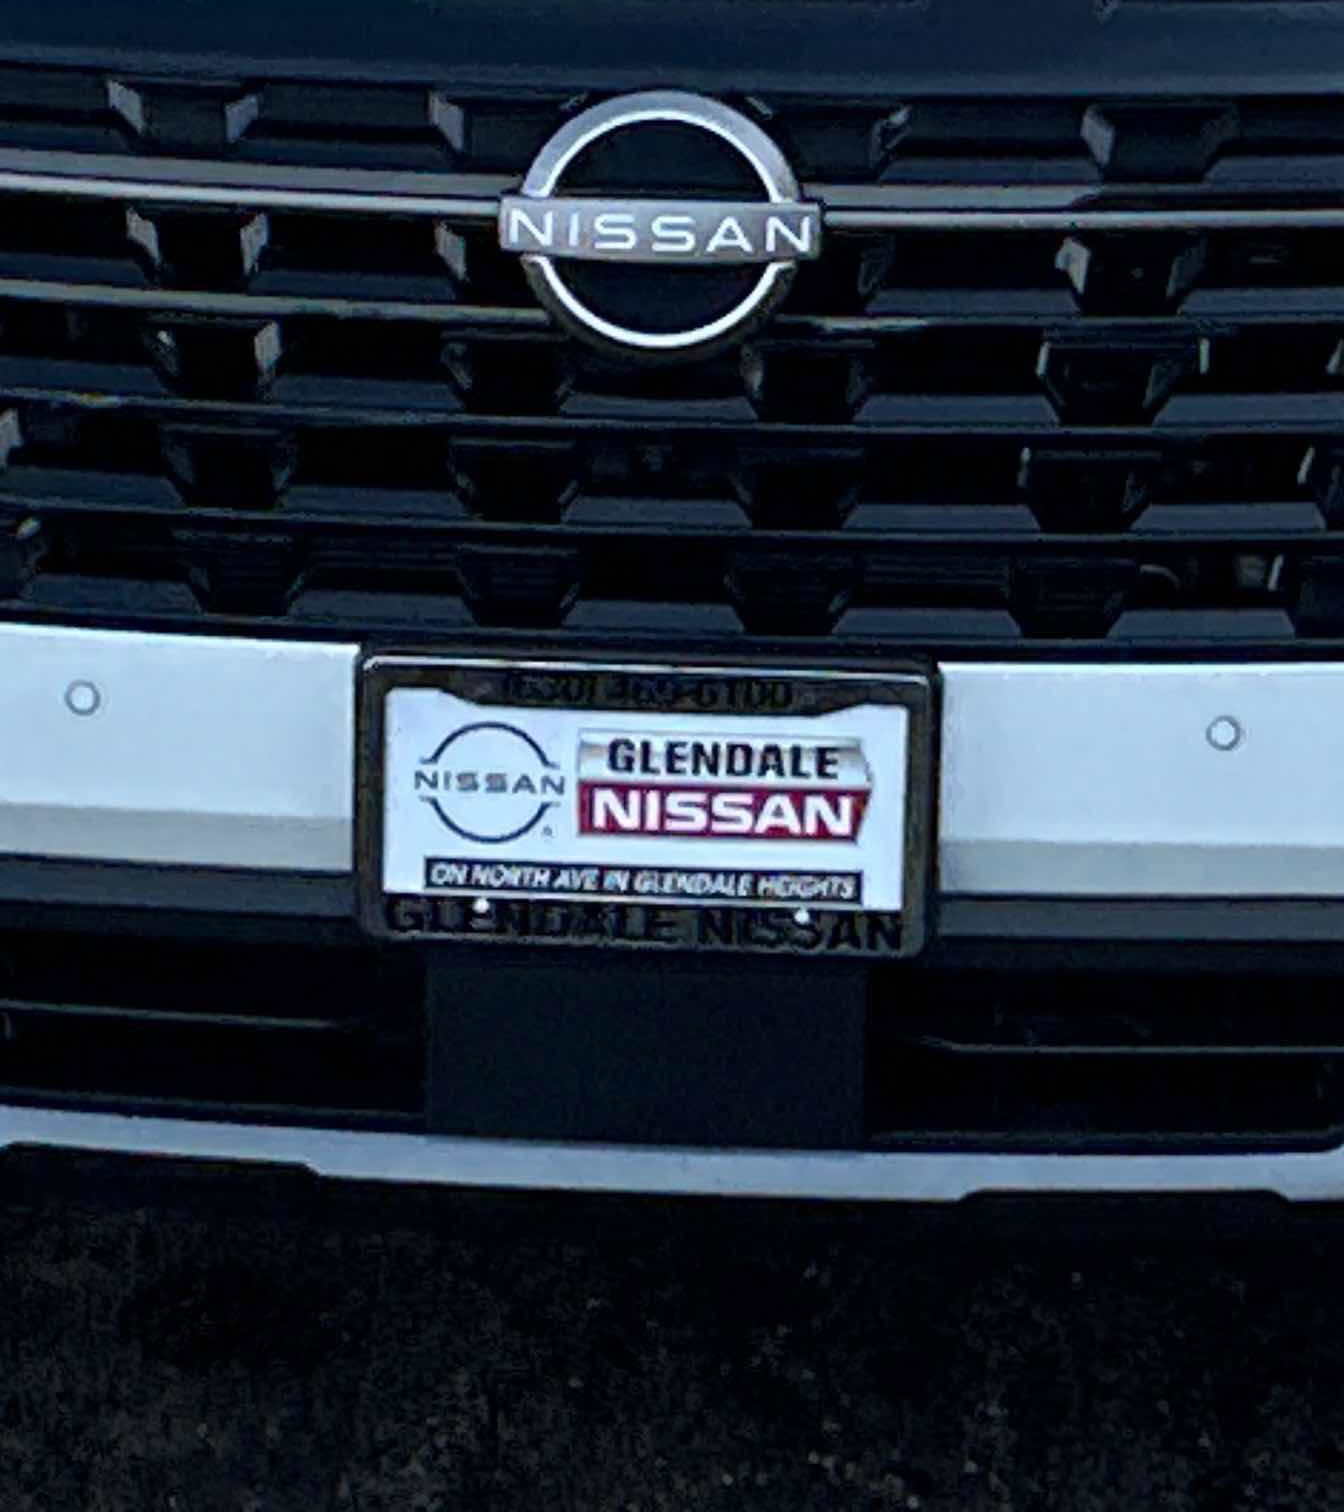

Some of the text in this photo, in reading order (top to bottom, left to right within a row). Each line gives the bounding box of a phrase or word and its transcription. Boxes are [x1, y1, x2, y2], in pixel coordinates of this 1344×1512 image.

[509, 207, 812, 253] NISSAN
[608, 737, 840, 779] GLENDALE
[414, 769, 565, 796] NISSAN
[592, 786, 854, 836] NISSAN
[431, 861, 856, 900] ON NORTH AVE IN GLENDALE HEIGHTS
[386, 894, 903, 951] GLENDALE NISSAN
